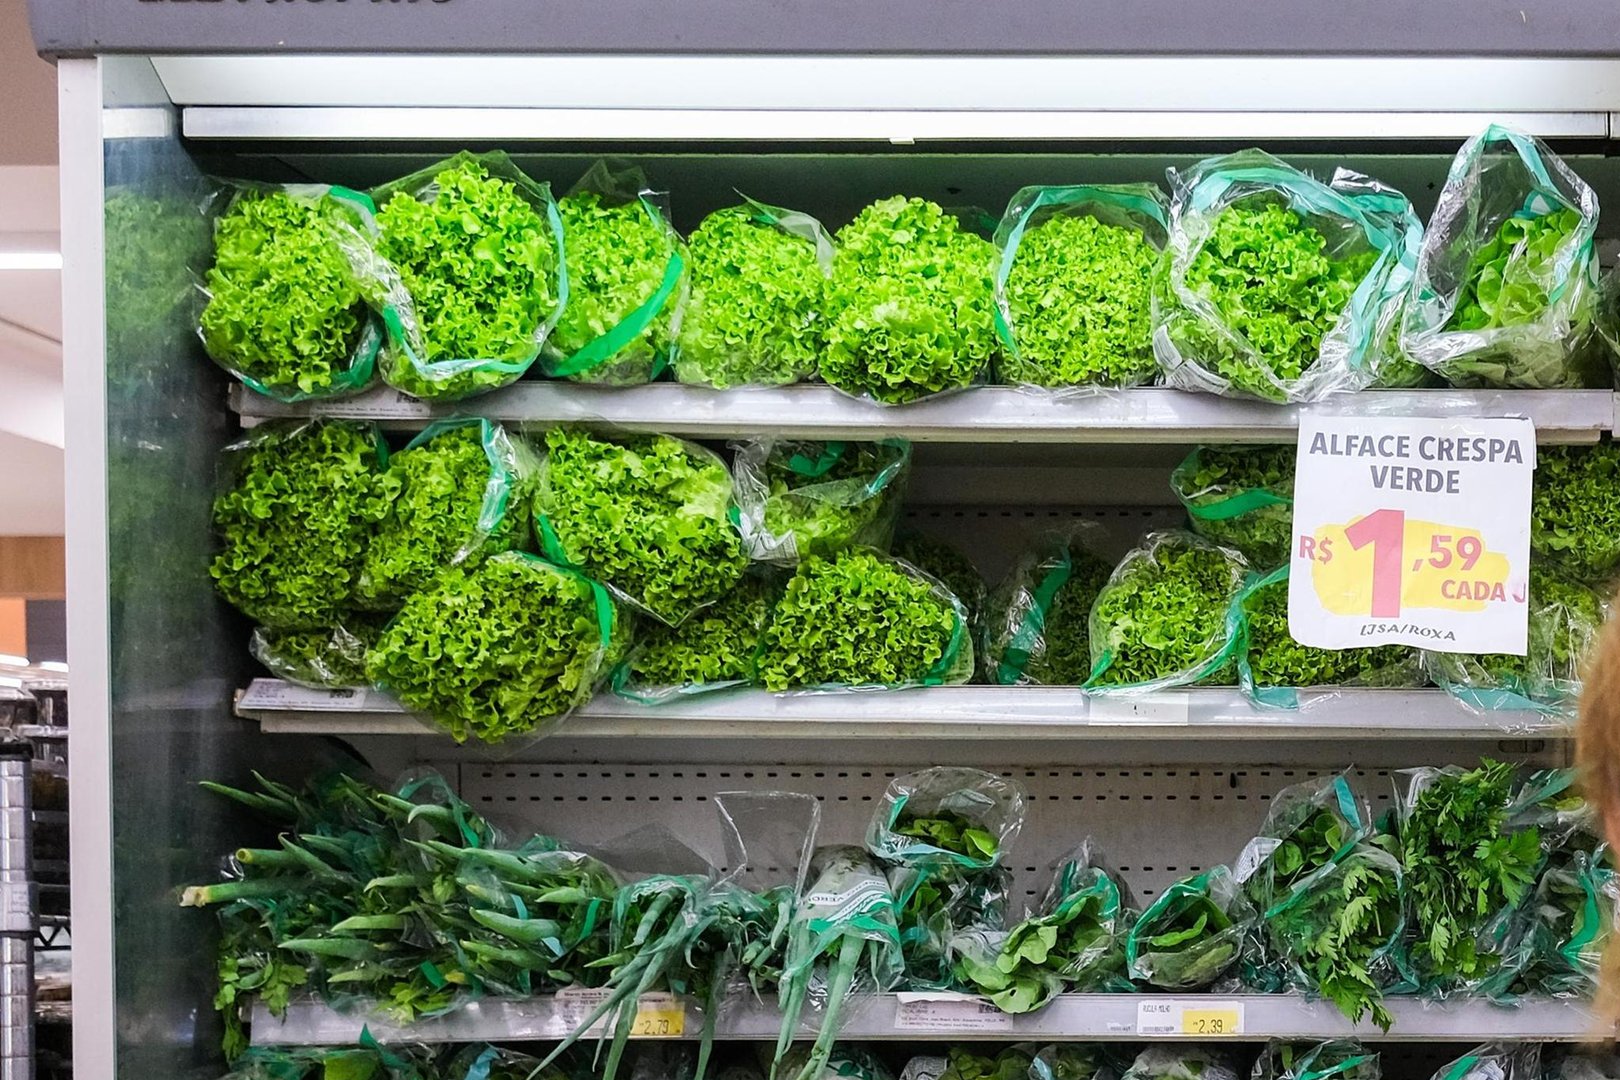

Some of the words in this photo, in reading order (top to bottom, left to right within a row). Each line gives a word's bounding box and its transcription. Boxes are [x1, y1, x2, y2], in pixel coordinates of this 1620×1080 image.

[1309, 431, 1411, 458] ALFACE
[1418, 436, 1524, 464] CRESPA
[1370, 465, 1461, 494] VERDE
[1299, 536, 1333, 565] R$
[1441, 579, 1507, 602] CADA
